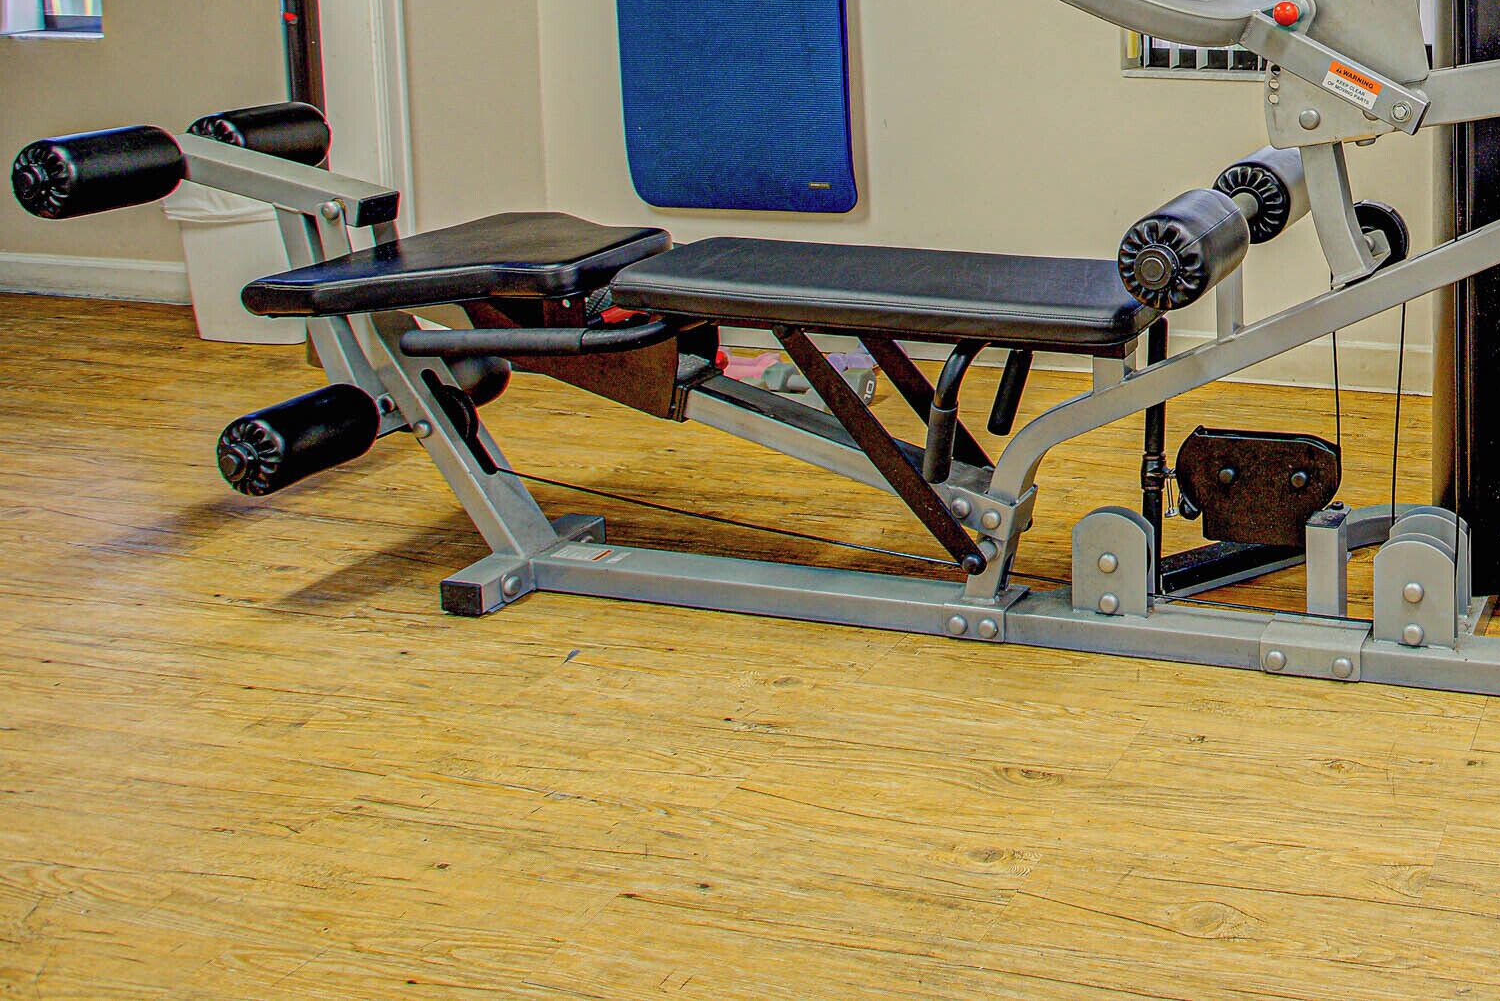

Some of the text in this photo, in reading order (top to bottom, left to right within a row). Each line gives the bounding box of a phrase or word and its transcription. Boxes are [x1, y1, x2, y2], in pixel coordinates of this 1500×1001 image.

[1336, 79, 1366, 97] KEEP CLEAR
[1343, 69, 1374, 89] WARNING
[1335, 83, 1353, 97] MOVING
[1353, 93, 1370, 105] PARTS
